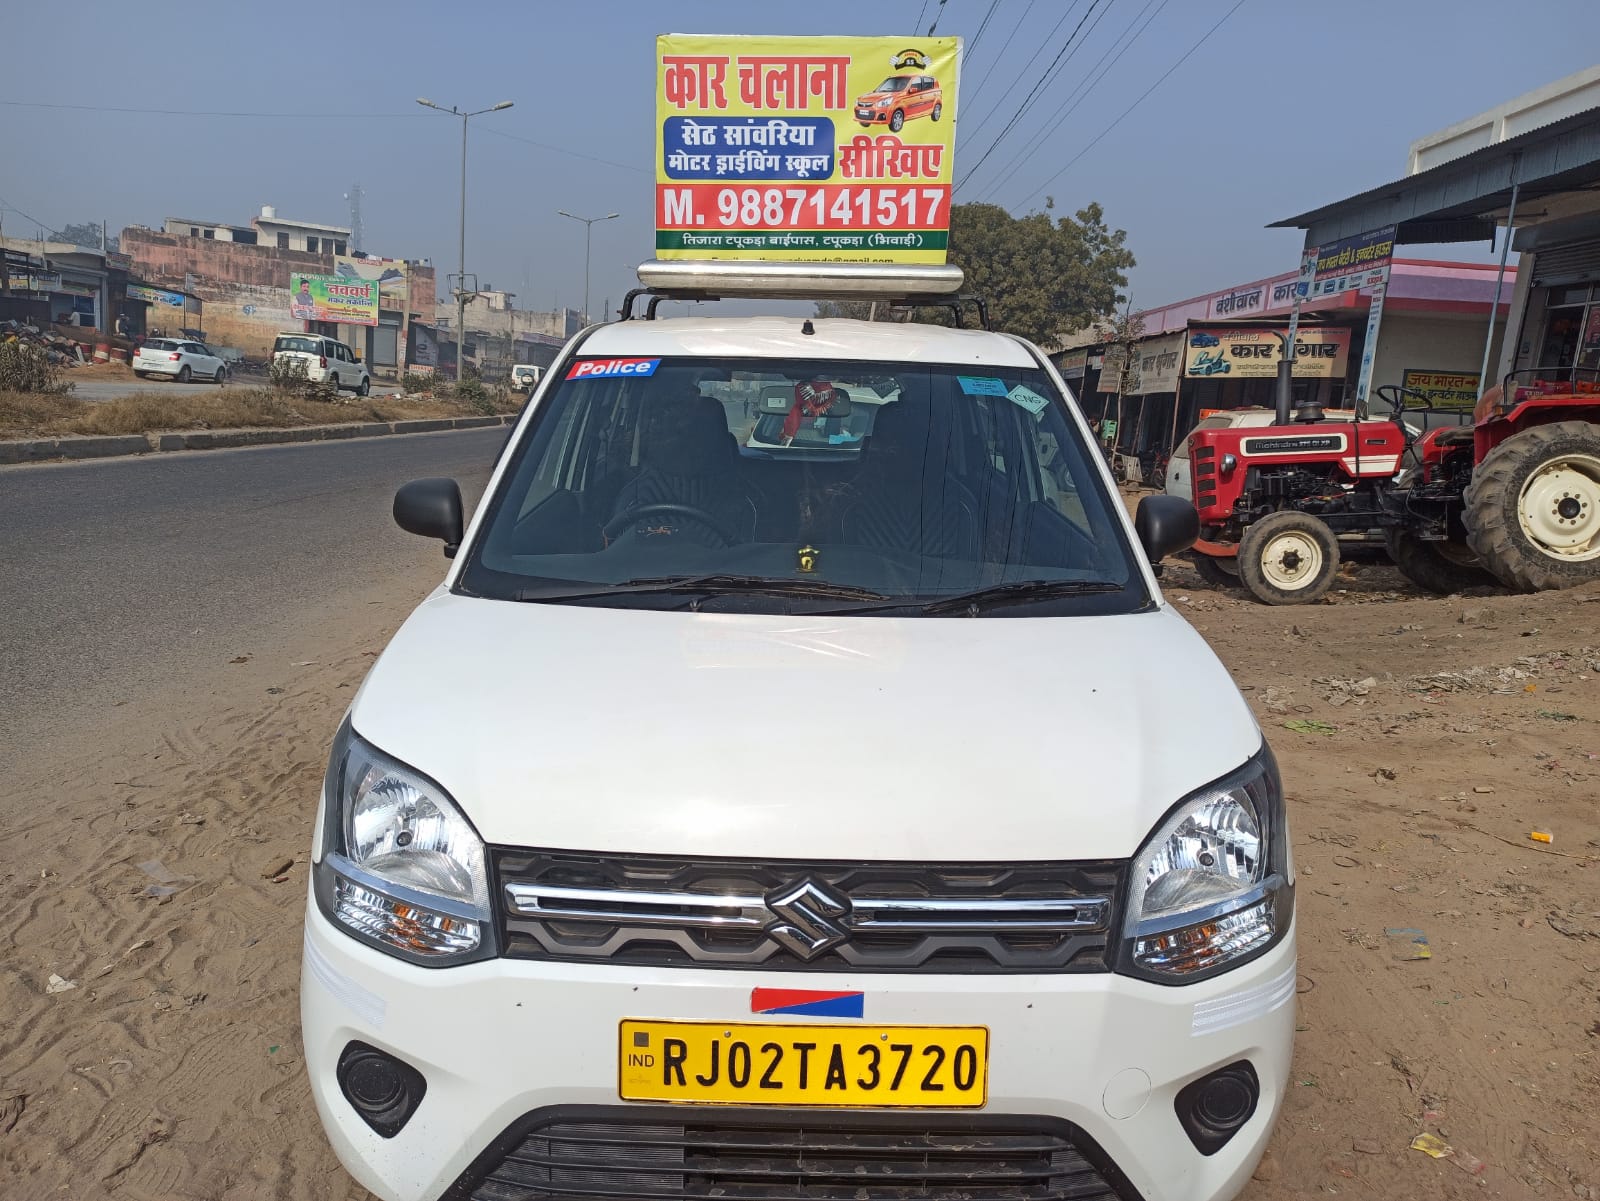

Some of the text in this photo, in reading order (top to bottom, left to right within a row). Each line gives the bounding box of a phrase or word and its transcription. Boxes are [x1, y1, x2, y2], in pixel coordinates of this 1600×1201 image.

[662, 56, 851, 109] कार चलाना
[681, 118, 817, 146] सेठ सांवरिया
[668, 149, 830, 178] मोटर ड्राईविंग स्कूल
[838, 135, 945, 178] सीखिए
[664, 188, 944, 226] M. 9887141517
[682, 232, 722, 245] तिजारा
[324, 283, 374, 298] नववर्ष
[1273, 282, 1298, 301] कार
[1230, 343, 1275, 358] कार
[575, 360, 651, 377] Police
[1408, 374, 1464, 388] जय भारत
[1014, 393, 1042, 404] CNG
[628, 1053, 655, 1068] IND
[662, 1038, 978, 1092] RJ02TA3720
